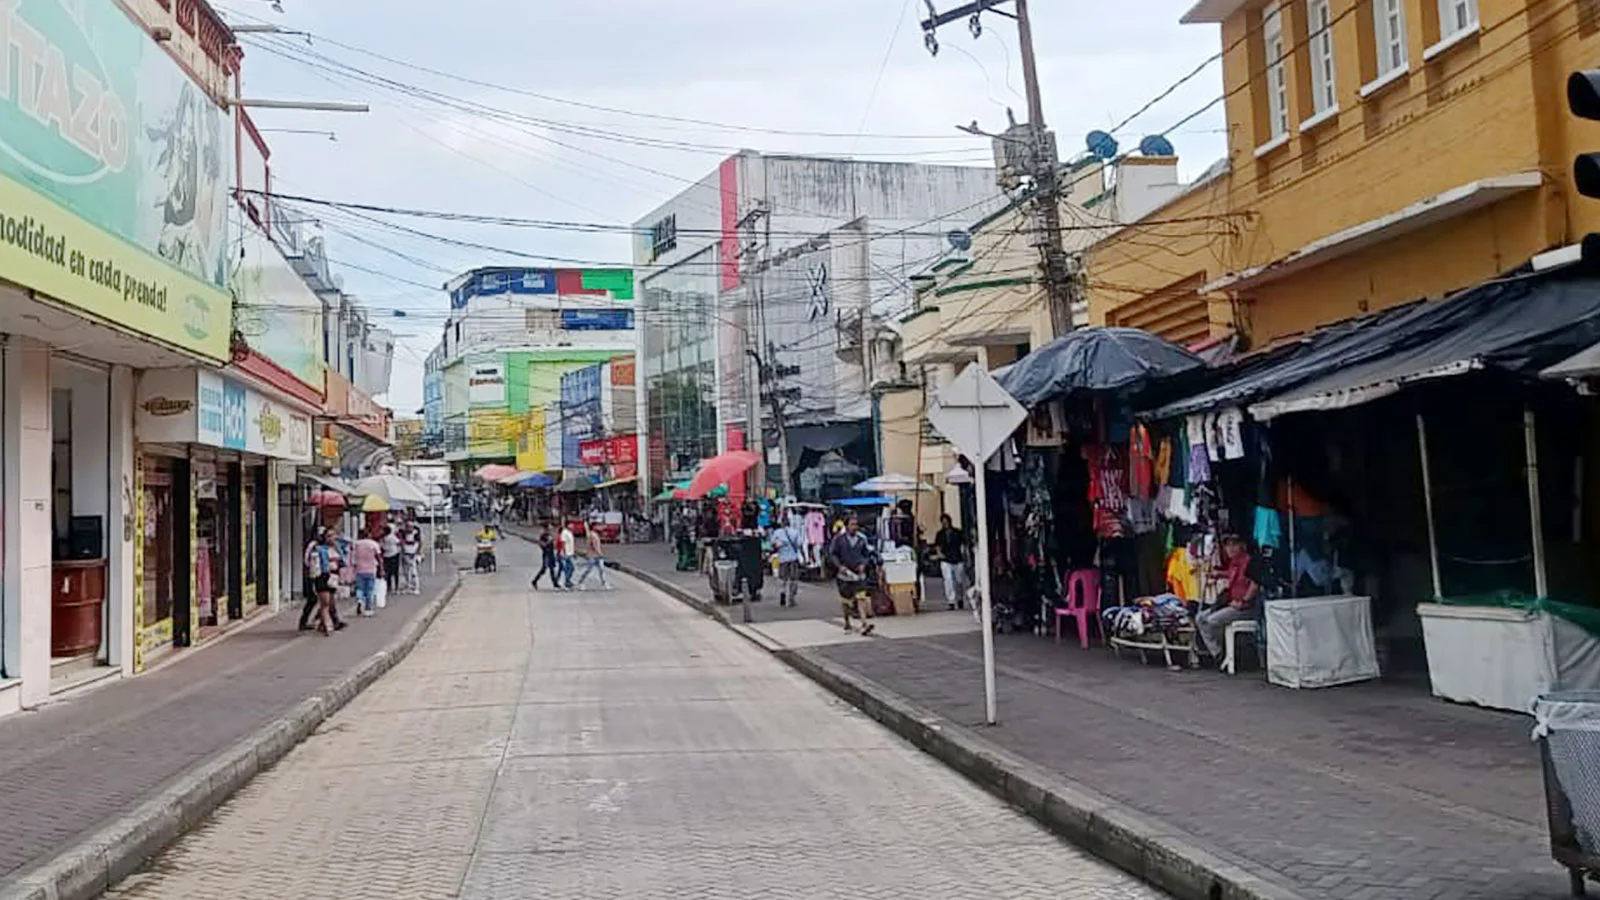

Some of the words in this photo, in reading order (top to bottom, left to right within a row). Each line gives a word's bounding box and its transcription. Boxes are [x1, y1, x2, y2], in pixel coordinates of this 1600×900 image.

[70, 249, 85, 277] en
[89, 258, 121, 293] cada
[123, 272, 167, 312] prenda!
